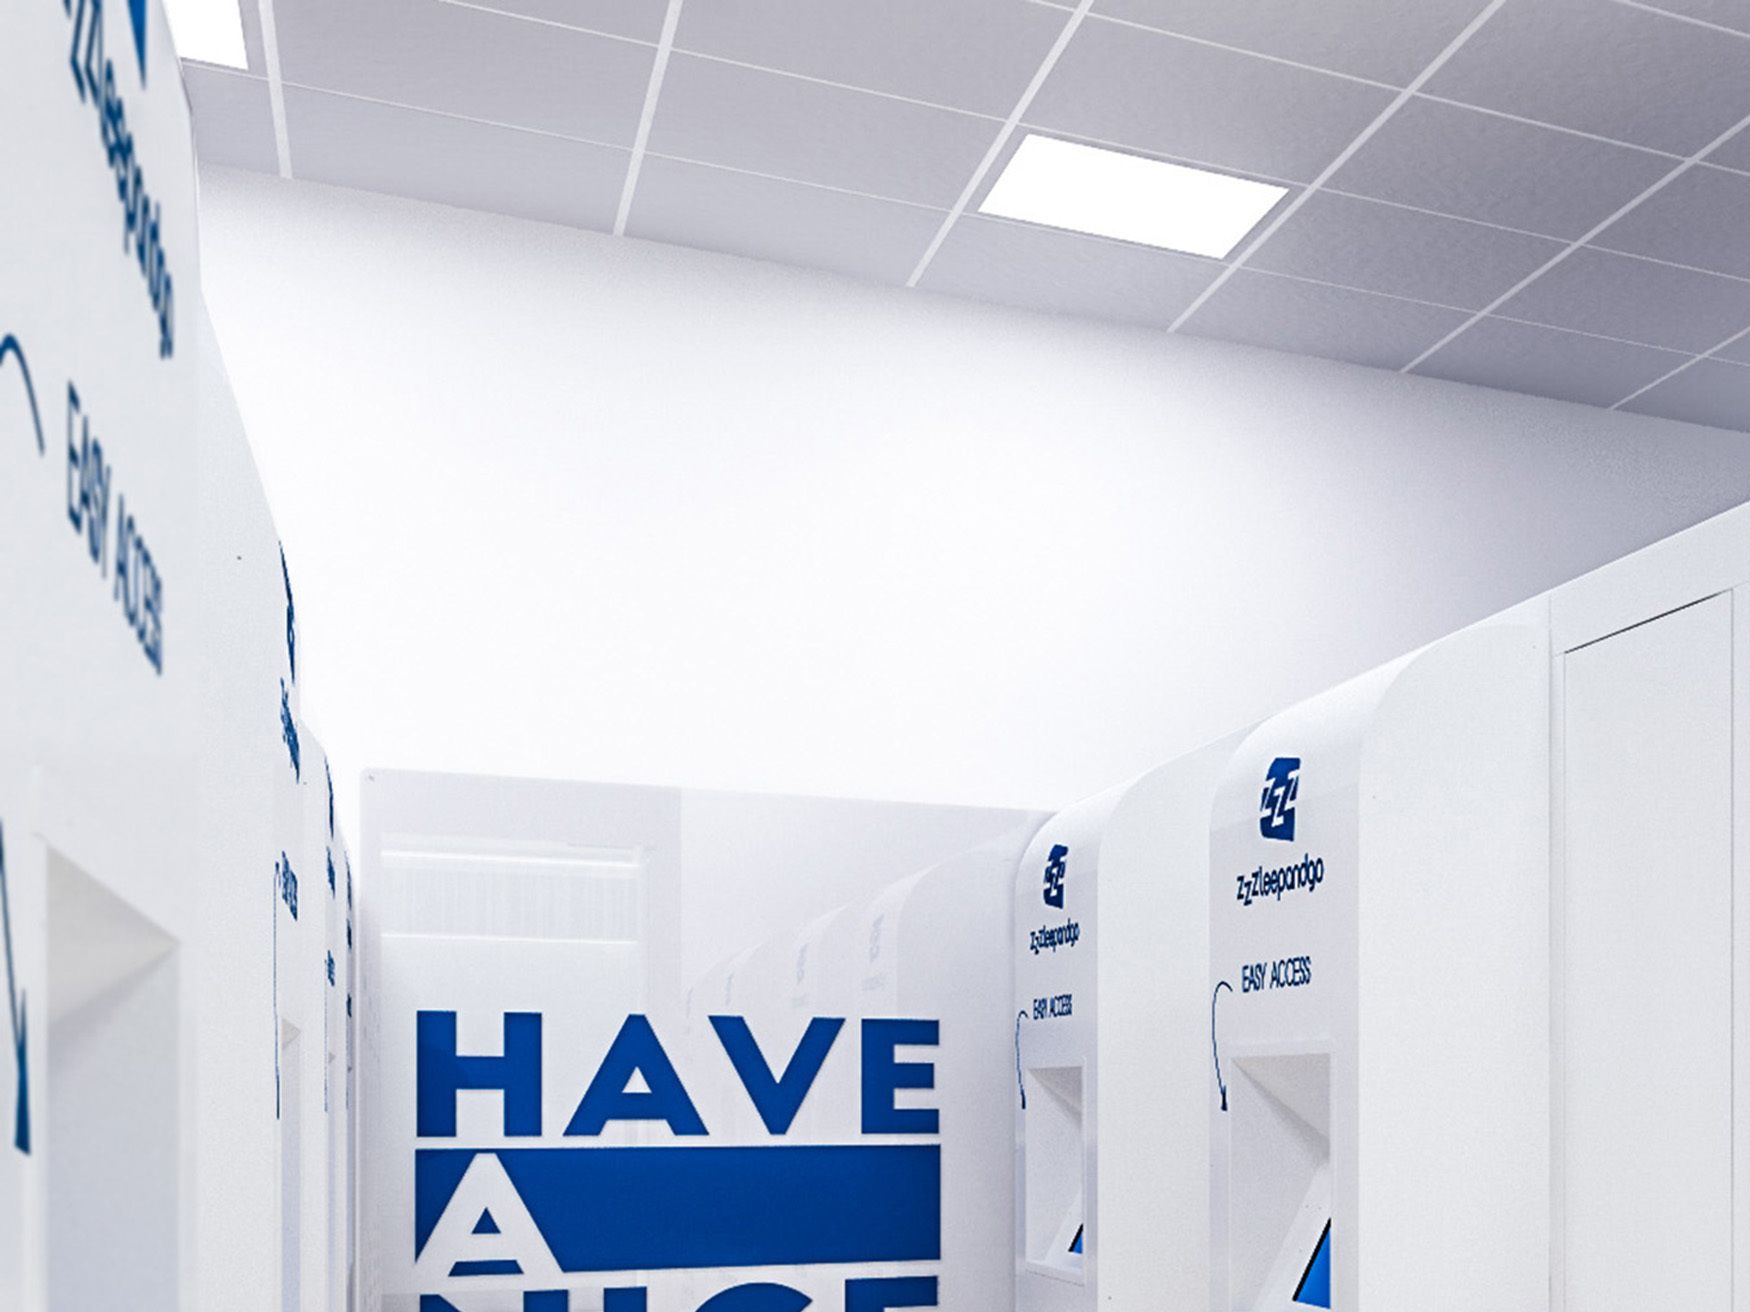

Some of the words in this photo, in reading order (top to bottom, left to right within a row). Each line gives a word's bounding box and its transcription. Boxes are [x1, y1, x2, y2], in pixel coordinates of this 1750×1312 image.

[67, 381, 111, 577] EASY
[114, 493, 162, 676] ACCESS
[1242, 963, 1267, 993] EASY
[1270, 956, 1311, 988] ACCESS
[417, 1011, 939, 1137] HAVE
[415, 1152, 563, 1277] A
